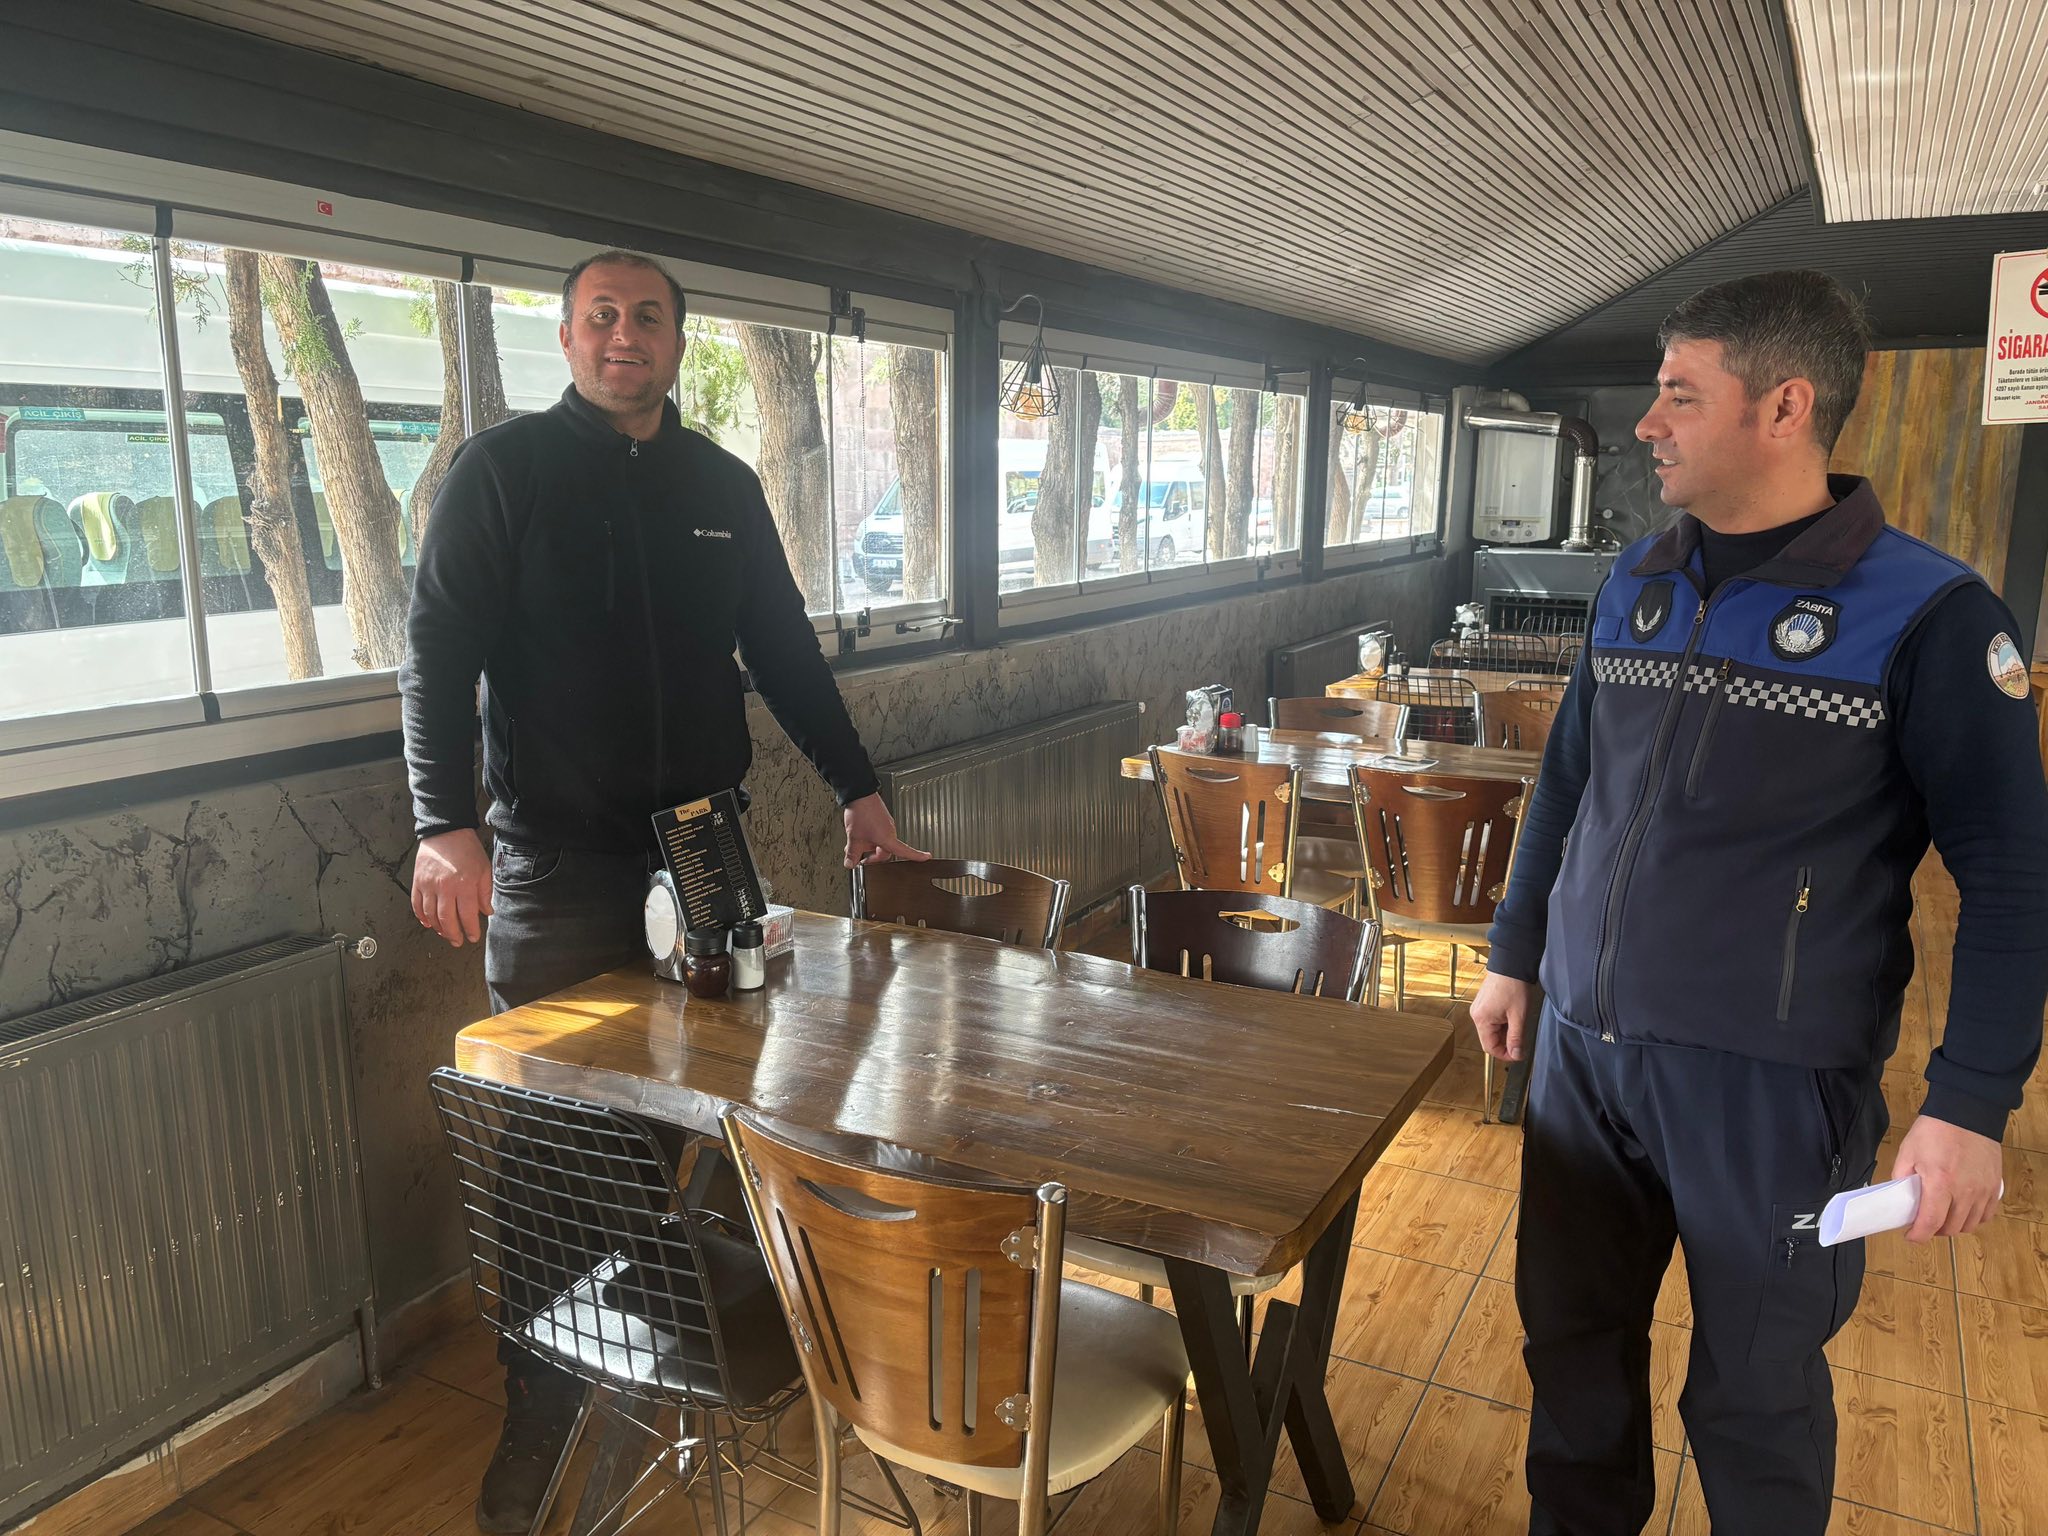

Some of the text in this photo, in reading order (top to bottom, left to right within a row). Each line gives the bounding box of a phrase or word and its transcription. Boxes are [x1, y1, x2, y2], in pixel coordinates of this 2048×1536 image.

[701, 529, 732, 538] Columbia
[1795, 600, 1834, 616] ZABITA
[690, 807, 708, 816] PARK
